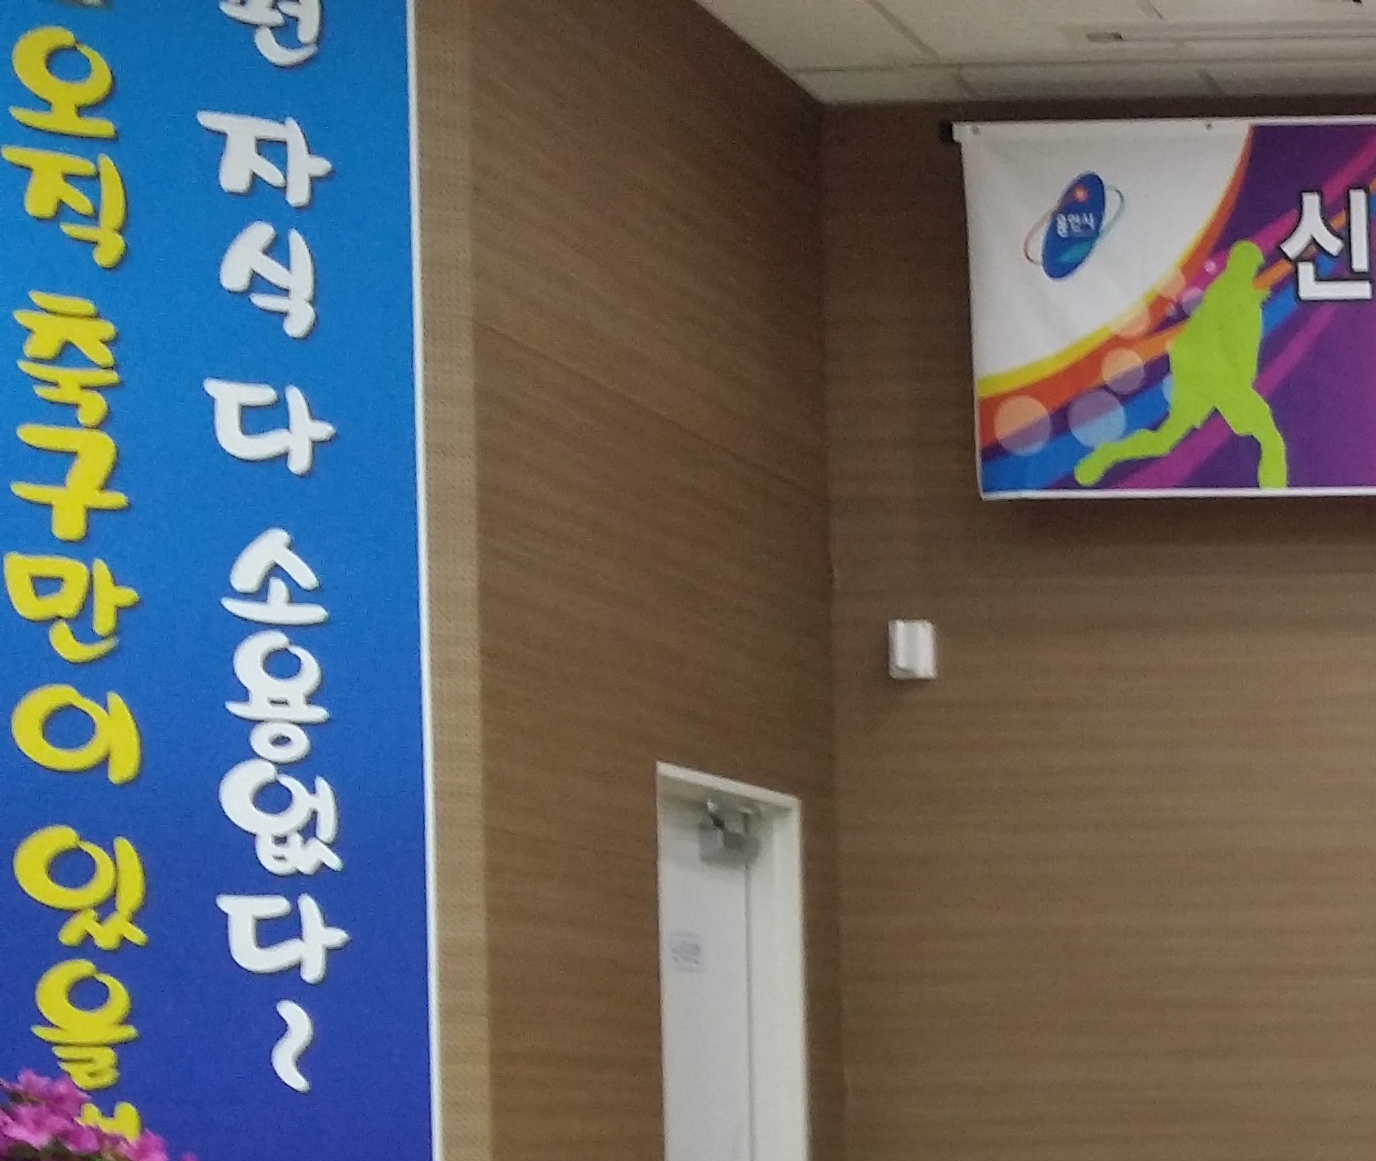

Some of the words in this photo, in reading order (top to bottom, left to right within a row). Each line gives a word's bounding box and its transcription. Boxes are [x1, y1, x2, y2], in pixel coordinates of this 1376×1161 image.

[0, 25, 129, 270] 오직
[196, 110, 334, 339] 자식
[3, 290, 141, 785] 축구만이
[202, 378, 337, 475] 다
